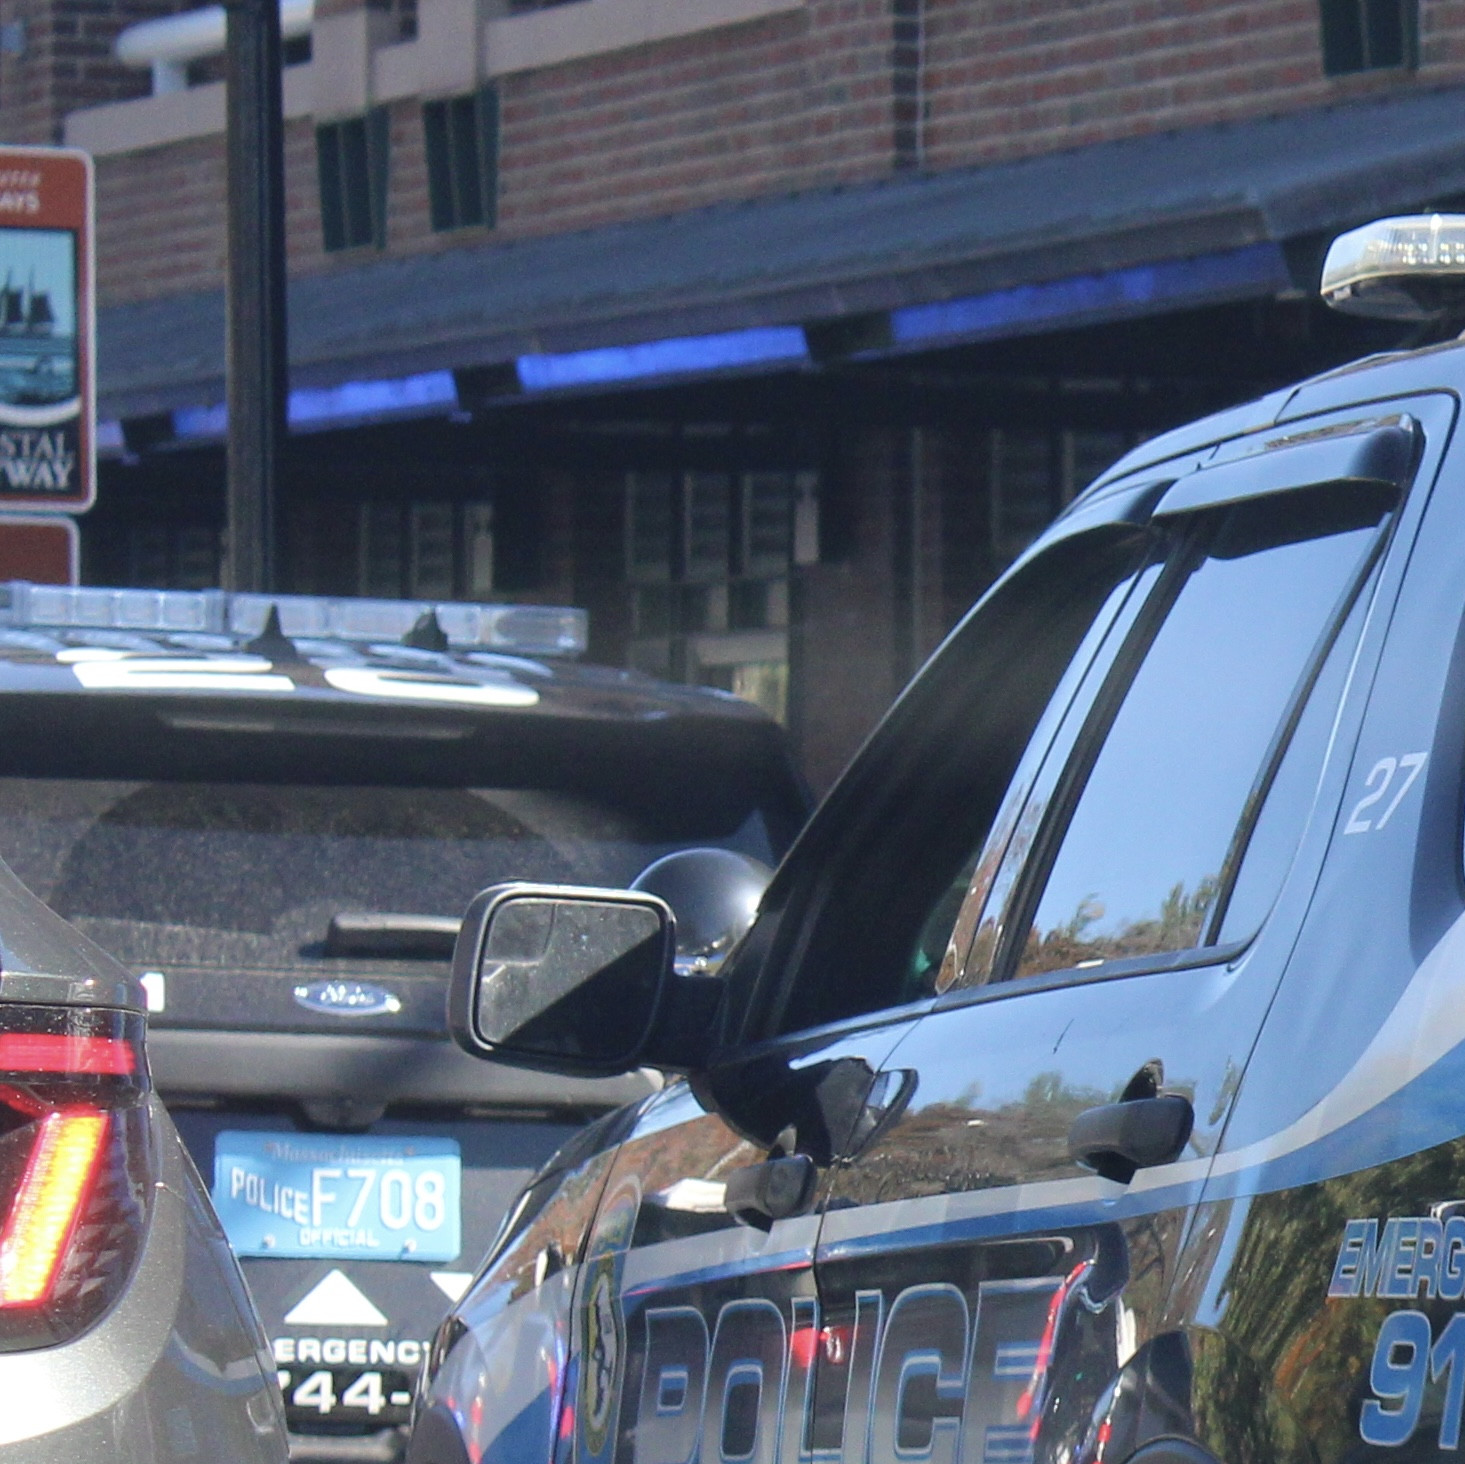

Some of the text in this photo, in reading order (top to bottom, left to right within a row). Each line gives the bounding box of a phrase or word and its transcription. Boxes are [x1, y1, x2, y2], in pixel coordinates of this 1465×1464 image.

[1344, 752, 1428, 834] 27
[231, 1166, 446, 1231] POLICE F708
[299, 1228, 379, 1248] OFFICIAL
